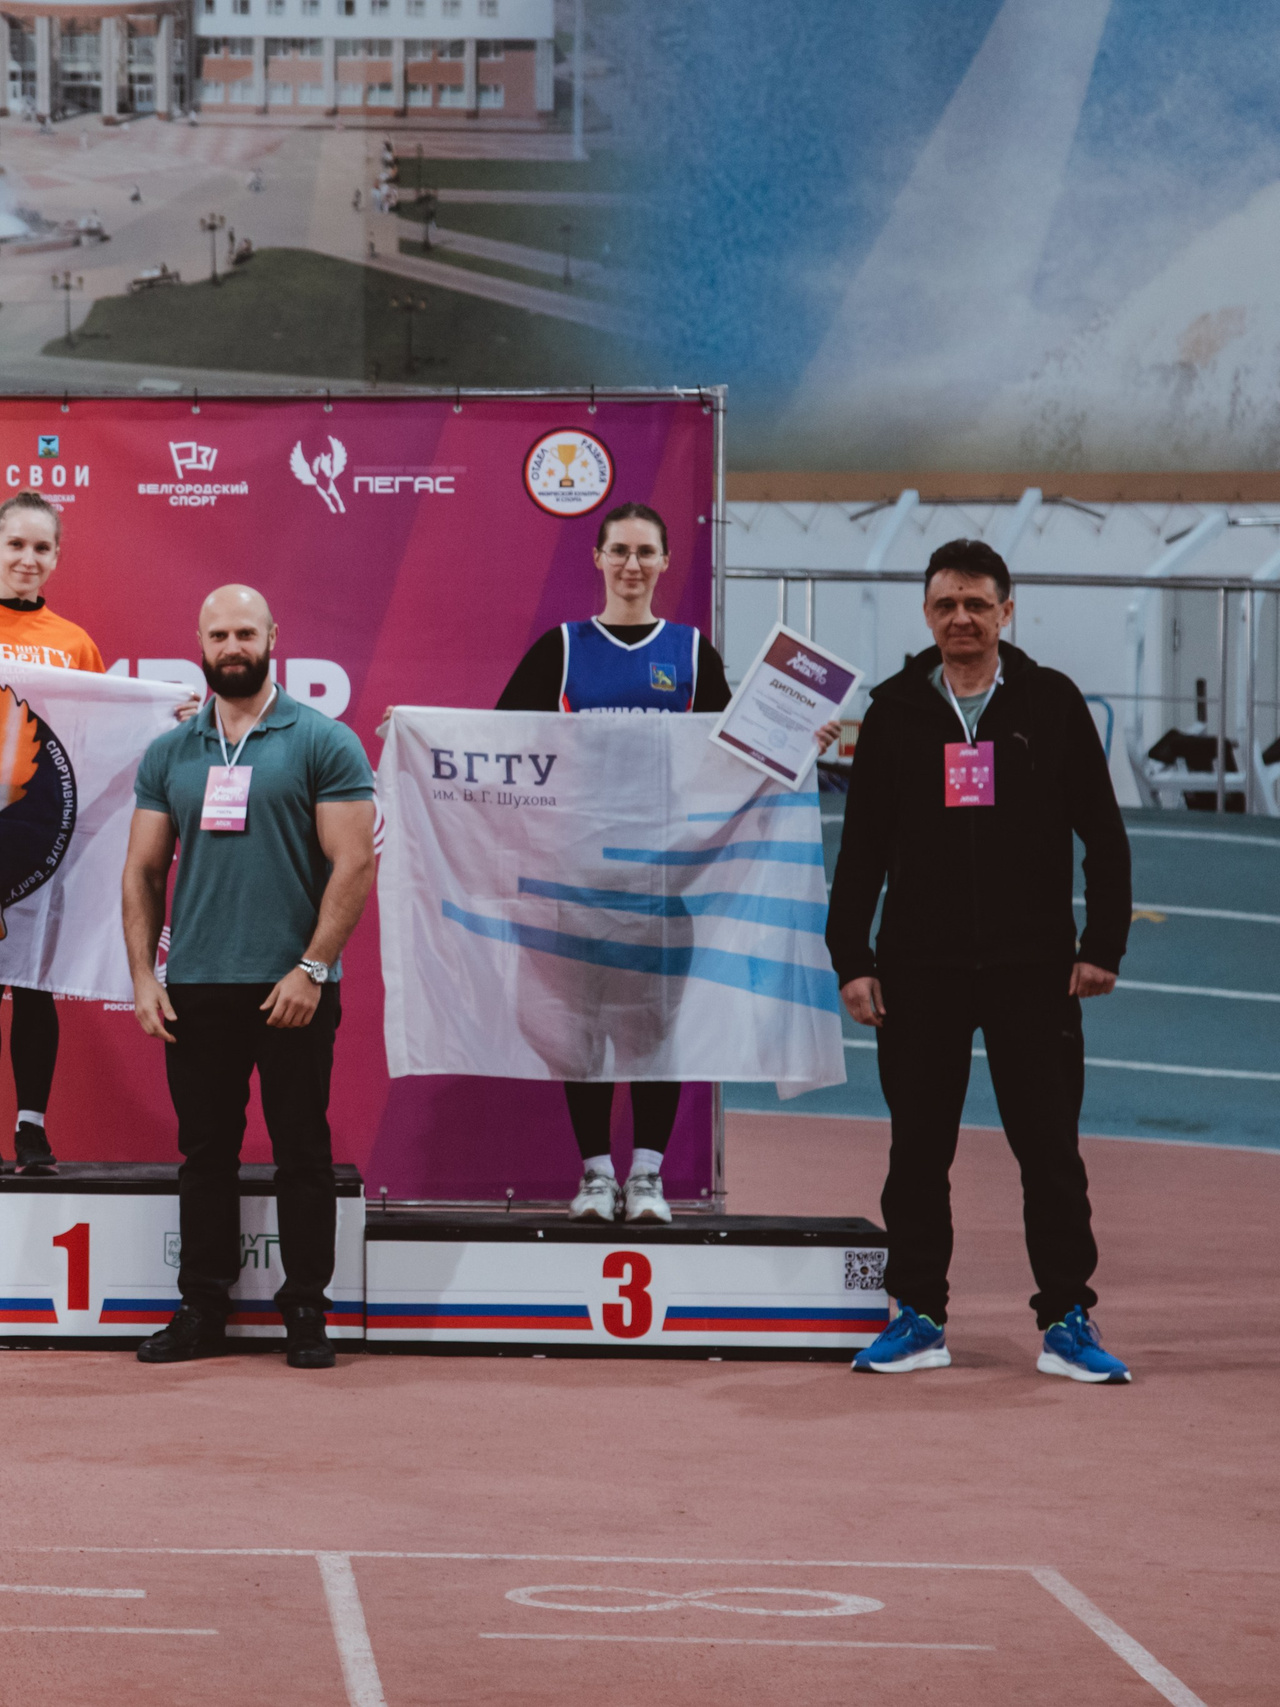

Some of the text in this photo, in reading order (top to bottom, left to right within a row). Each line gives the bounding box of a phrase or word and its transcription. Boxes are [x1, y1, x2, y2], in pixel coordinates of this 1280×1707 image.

[6, 464, 90, 487] СВОИ
[531, 448, 549, 481] ОТДЕЛ
[581, 438, 607, 483] РАЗВИТИЯ
[138, 481, 249, 495] БЕЛГОРОДСКИЙ
[169, 495, 217, 506] СПОРТ
[353, 476, 455, 494] ПЕГАС
[769, 678, 817, 709] ДИПЛОМ
[430, 748, 558, 786] БГТУ
[46, 739, 74, 831] СПОРТИВНЫЙ
[433, 789, 557, 809] им. В. Г. Шухова
[46, 832, 68, 867] КЛУБ
[52, 1223, 90, 1311] 1
[602, 1251, 653, 1339] 3
[504, 1584, 886, 1618] 8
